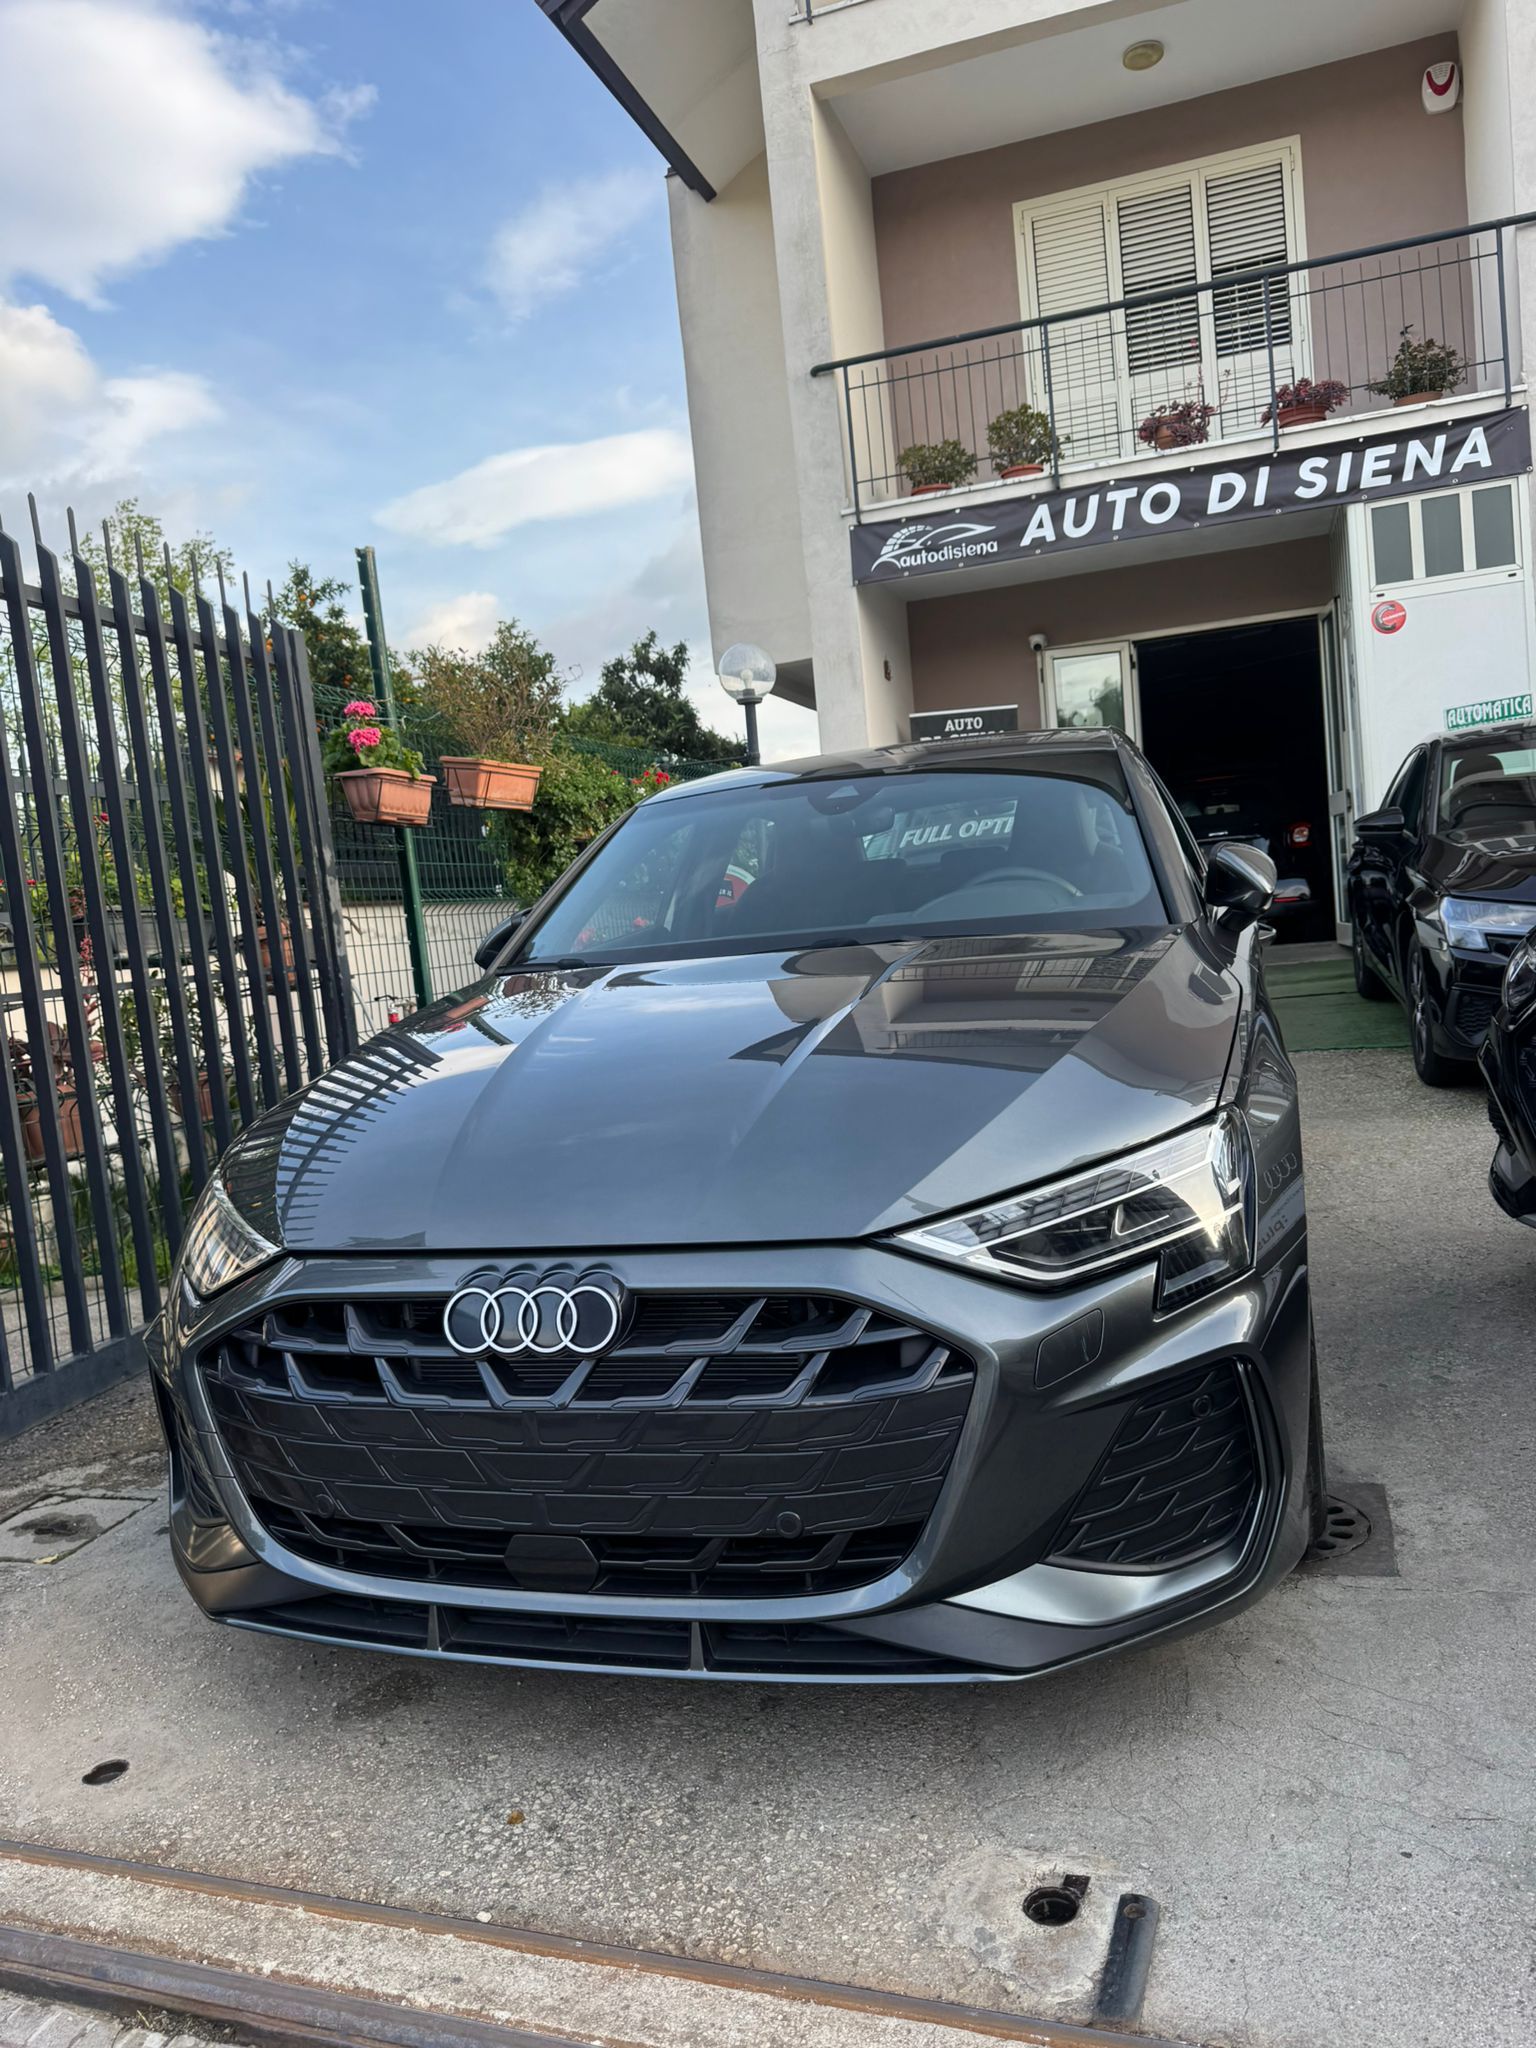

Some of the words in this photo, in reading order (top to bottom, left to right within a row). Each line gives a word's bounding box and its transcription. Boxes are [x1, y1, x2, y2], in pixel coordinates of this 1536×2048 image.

[1019, 481, 1182, 548] AUTO
[1206, 466, 1270, 515] DI
[1294, 426, 1492, 499] SIENA
[900, 540, 998, 568] autodisiena
[944, 717, 983, 732] AUTO
[1447, 695, 1532, 728] AUTOMATICA
[900, 824, 952, 848] FULL
